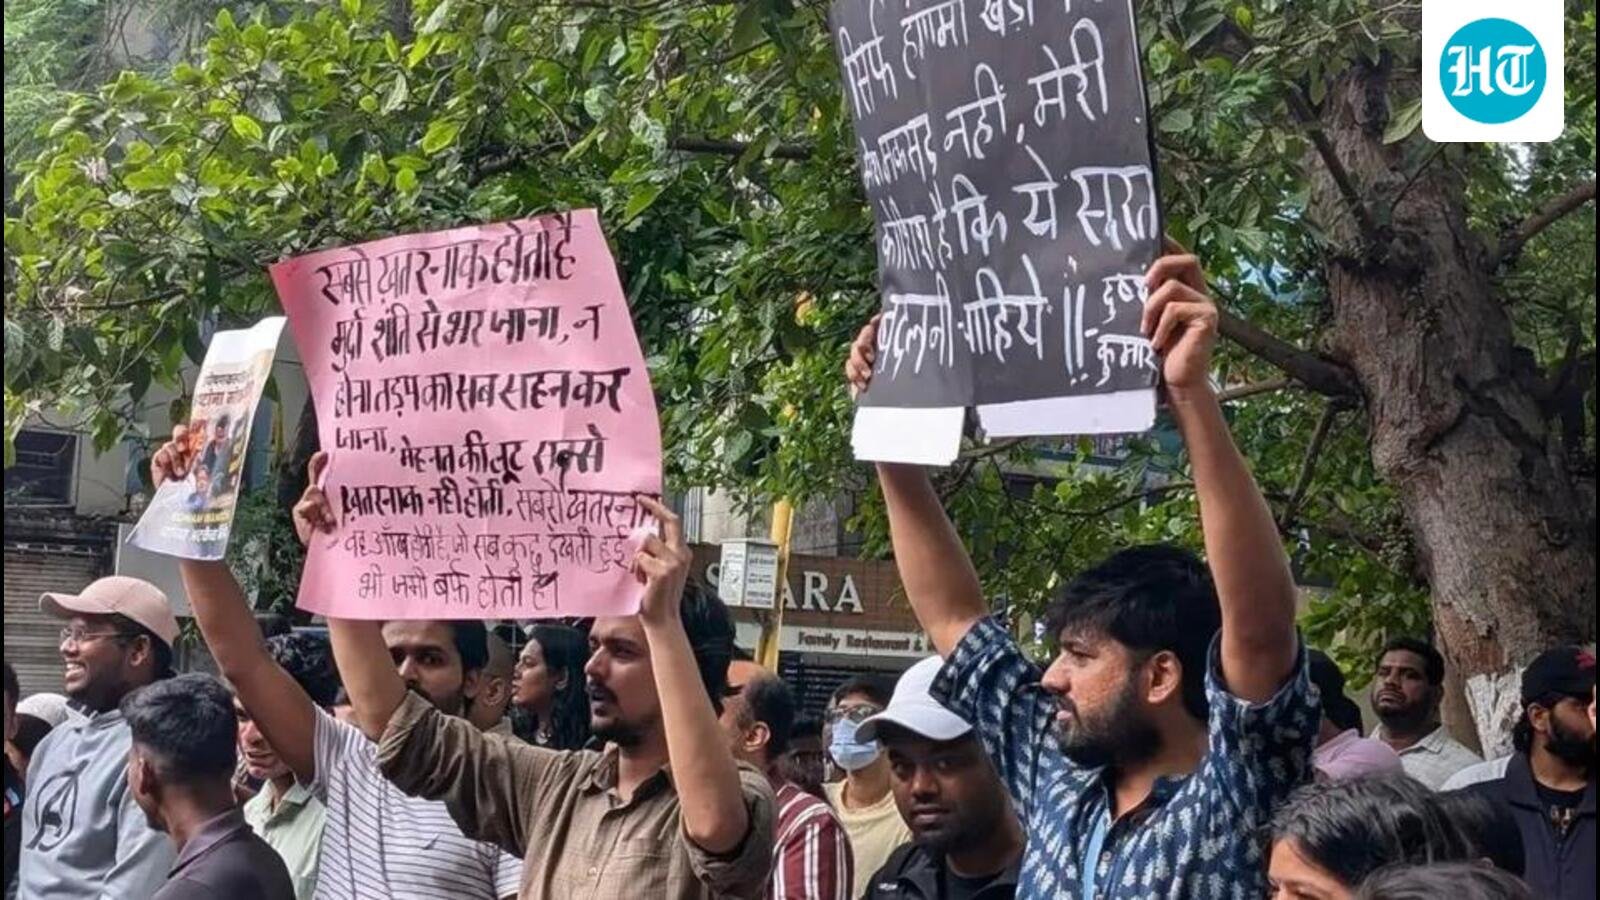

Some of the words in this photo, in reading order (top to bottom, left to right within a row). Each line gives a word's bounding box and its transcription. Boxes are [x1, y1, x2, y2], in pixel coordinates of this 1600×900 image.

[1027, 18, 1108, 127] मेरी
[951, 173, 1007, 256] कि
[1012, 145, 1059, 239] ये
[315, 247, 372, 305] सबसे
[416, 298, 441, 353] से
[442, 310, 486, 348] भर
[573, 304, 605, 341] न
[1096, 333, 1158, 387] कुमार
[422, 372, 454, 412] का
[572, 367, 631, 413] कर
[459, 430, 489, 473] की
[567, 489, 662, 528] खतरना
[798, 631, 841, 650] Family
[846, 634, 911, 651] Restaurant
